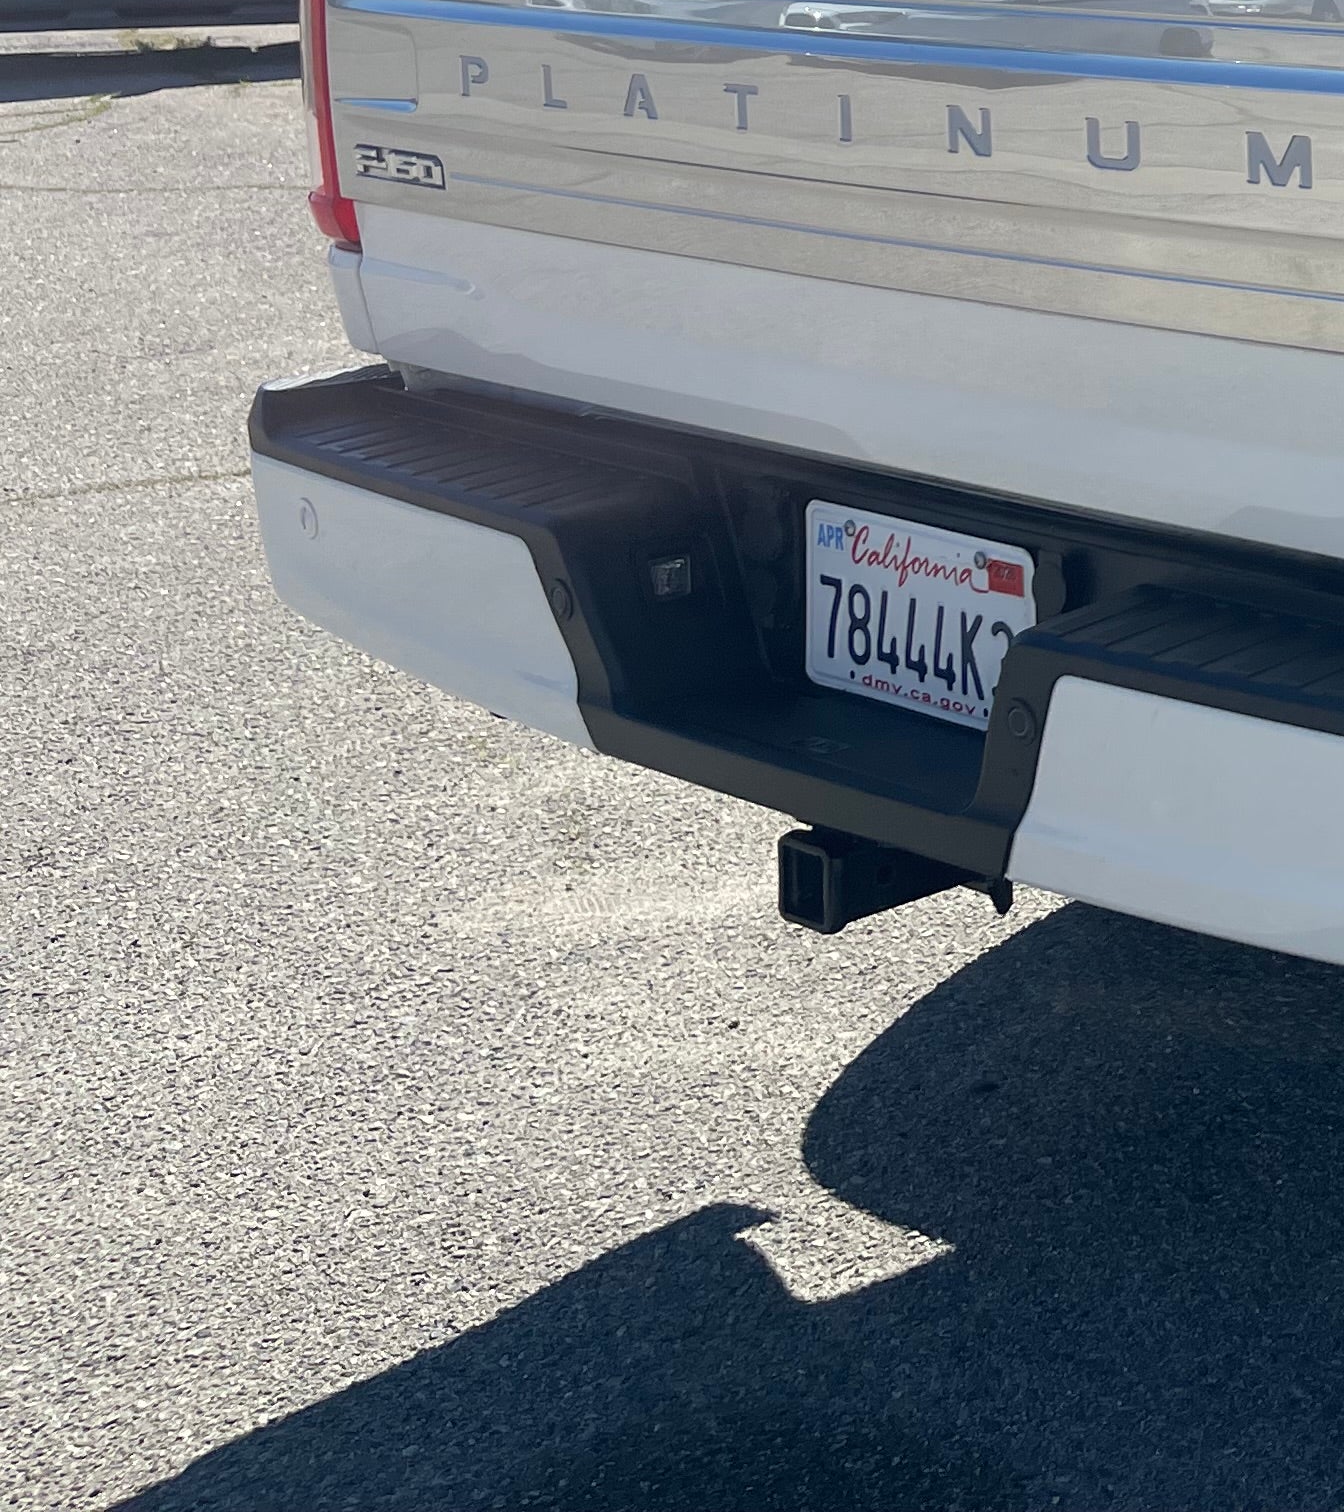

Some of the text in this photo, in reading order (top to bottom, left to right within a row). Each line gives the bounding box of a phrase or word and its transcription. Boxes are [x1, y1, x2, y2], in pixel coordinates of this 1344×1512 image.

[458, 54, 1313, 189] PLATINUM
[354, 143, 446, 190] F-150
[817, 523, 844, 551] APR
[851, 524, 989, 593] California
[862, 674, 976, 717] dmv.ca.gov
